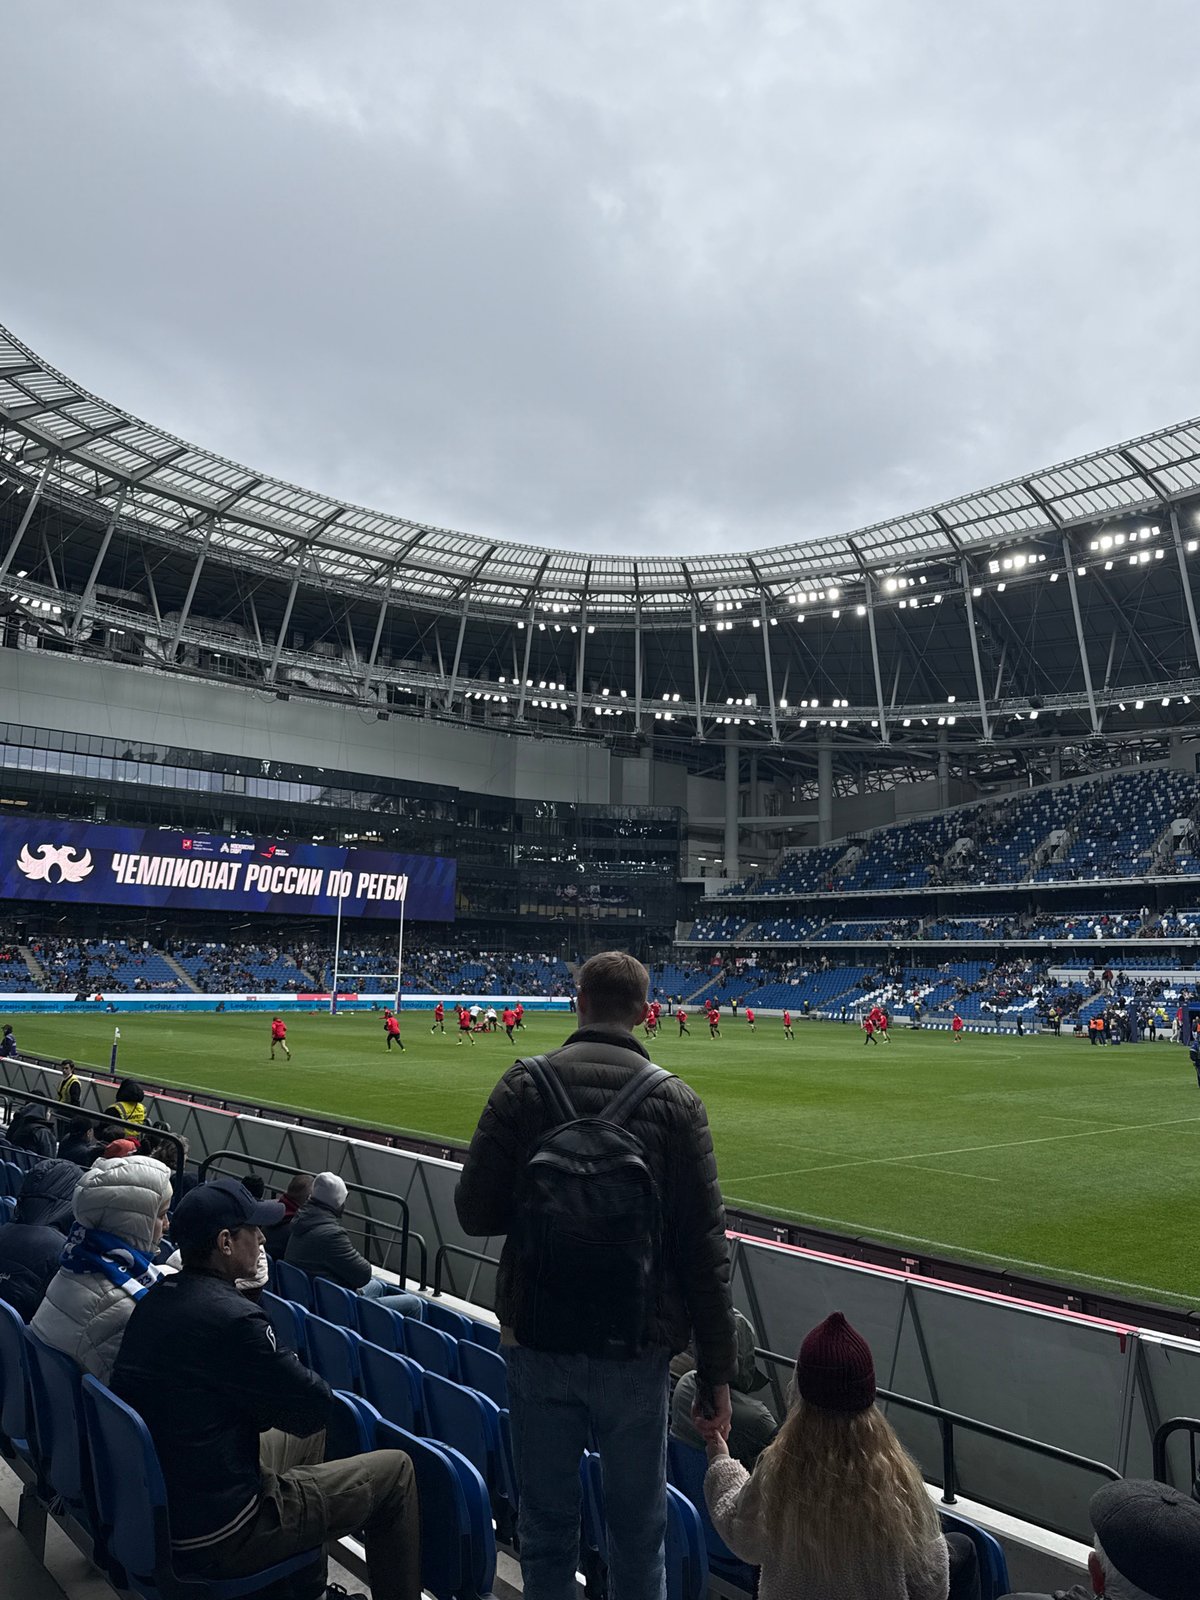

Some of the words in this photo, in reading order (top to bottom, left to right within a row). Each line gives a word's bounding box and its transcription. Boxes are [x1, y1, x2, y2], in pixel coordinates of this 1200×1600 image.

[111, 853, 242, 891] ЧЕМПИОНАТ
[243, 863, 323, 896] РОССИИ
[326, 870, 353, 898] ПО
[356, 873, 408, 901] РЕГБИ
